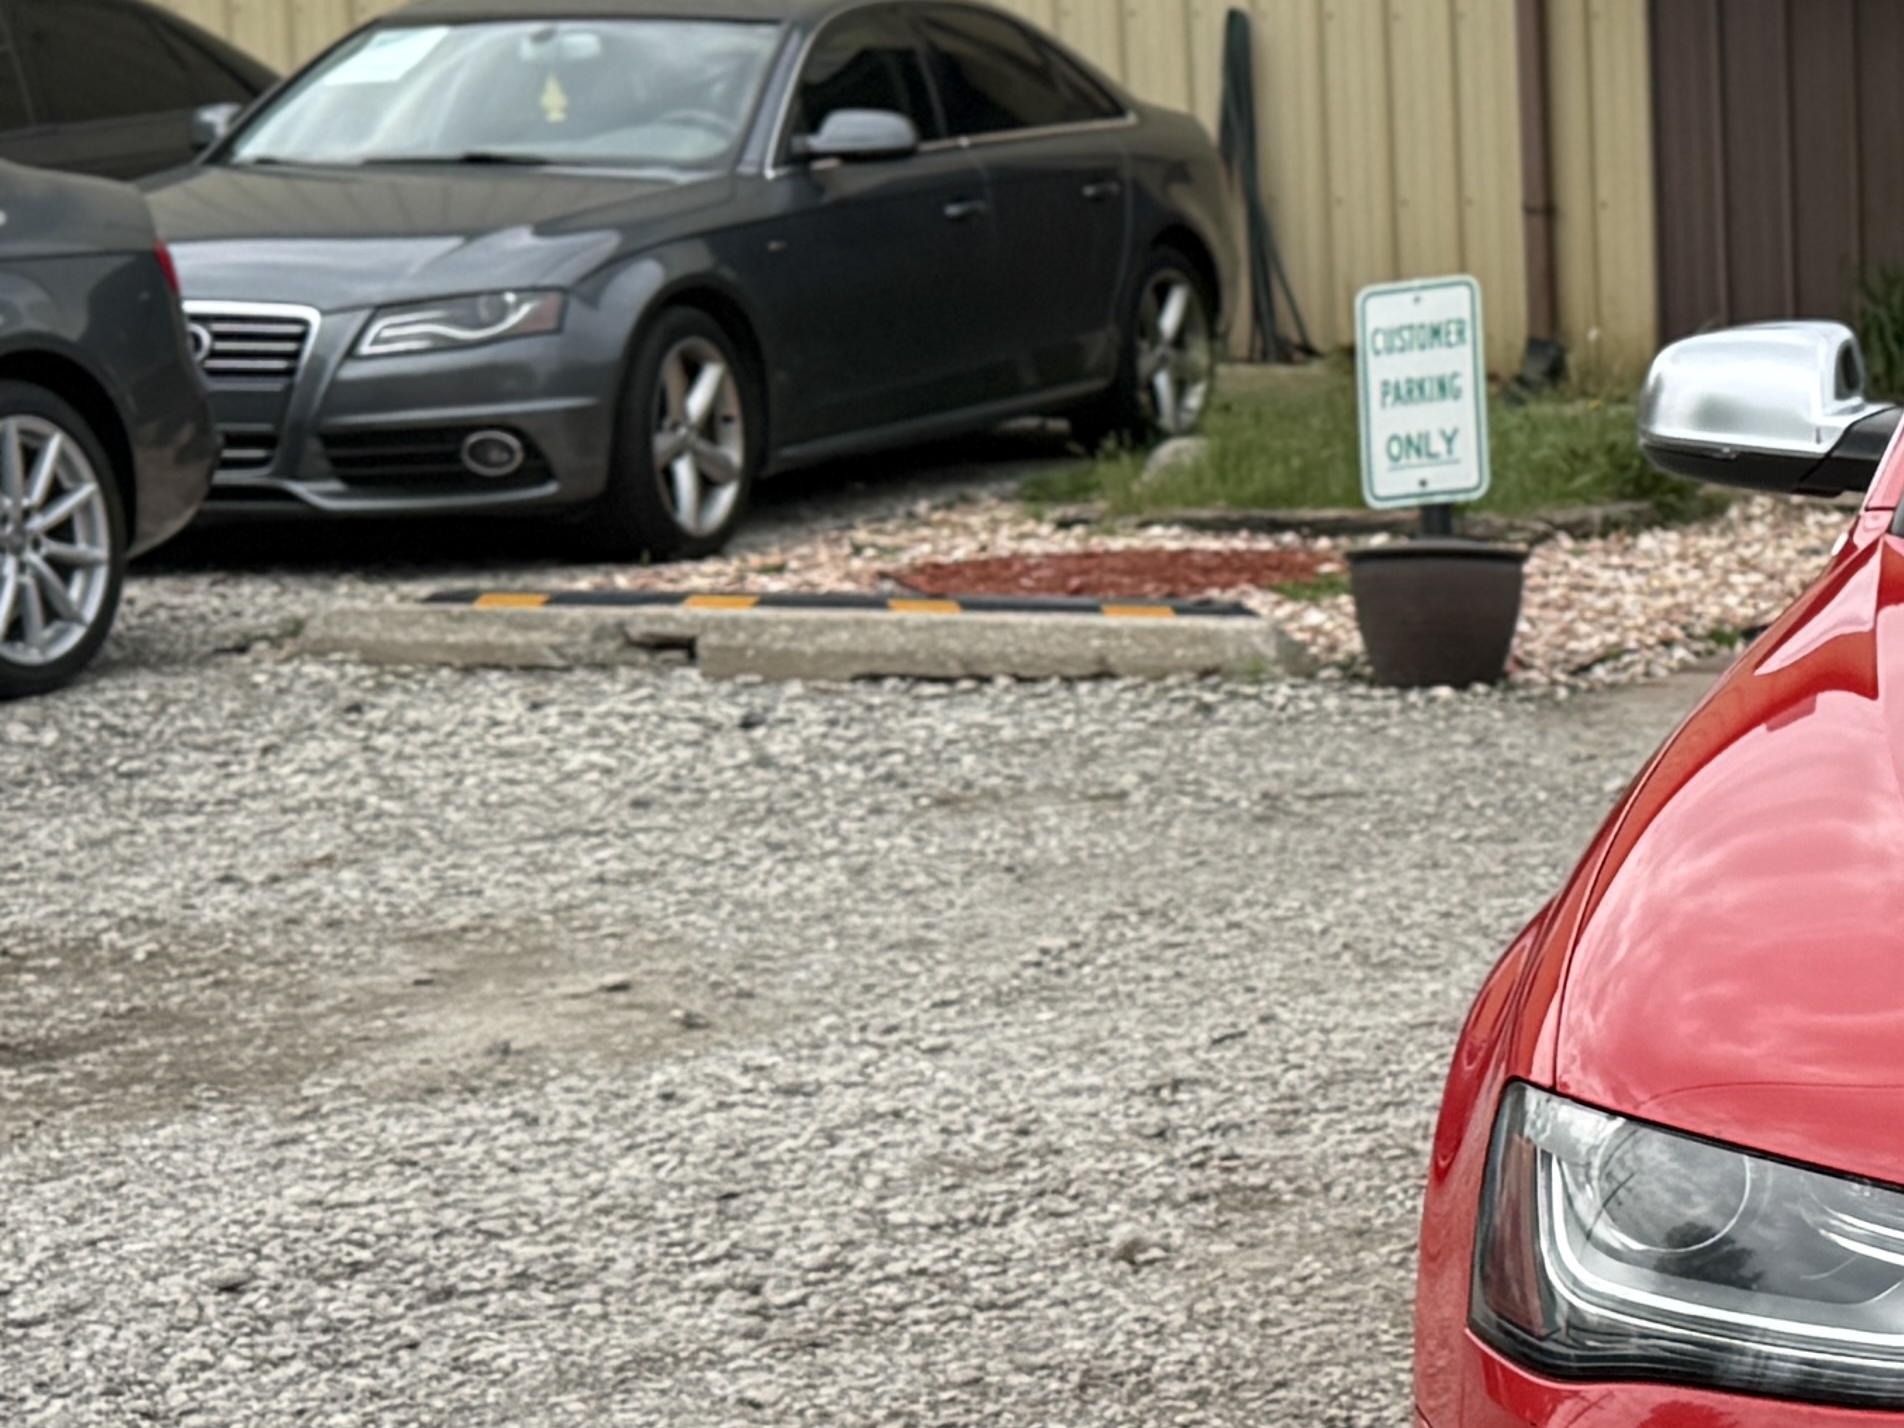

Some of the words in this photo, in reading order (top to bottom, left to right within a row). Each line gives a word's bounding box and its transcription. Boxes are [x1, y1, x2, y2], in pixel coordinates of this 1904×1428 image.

[1372, 319, 1466, 356] CUSTOMER
[1380, 371, 1462, 409] PARKING
[1386, 427, 1459, 462] ONLY
